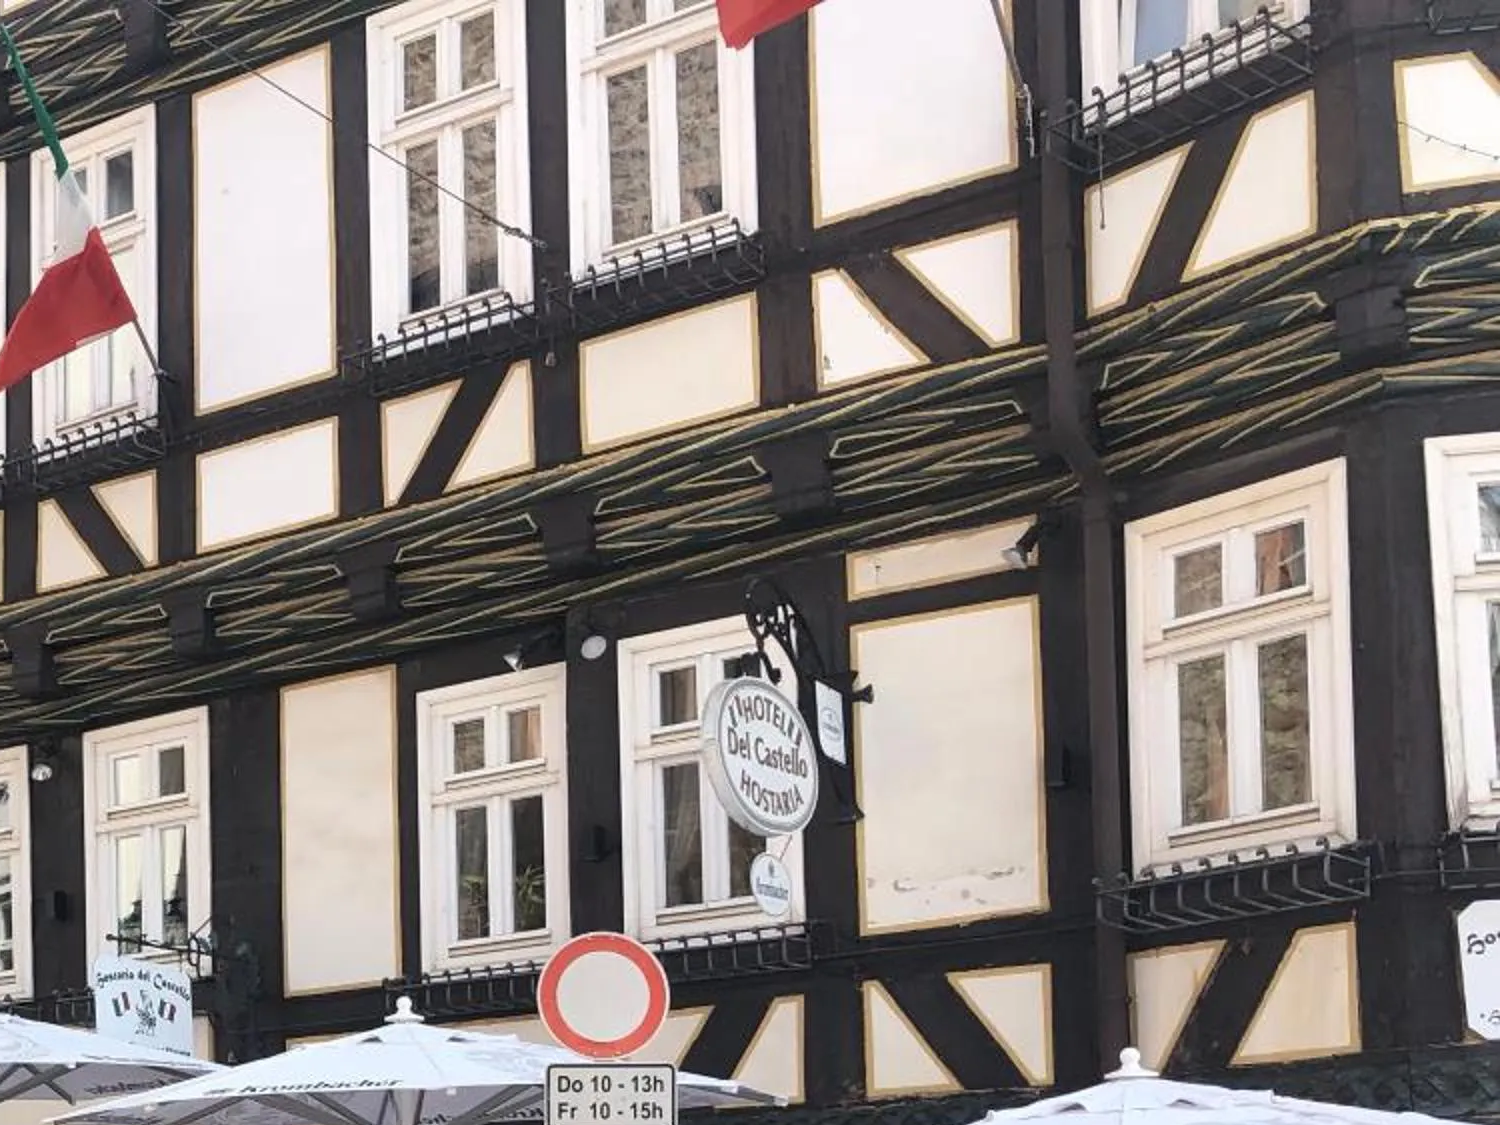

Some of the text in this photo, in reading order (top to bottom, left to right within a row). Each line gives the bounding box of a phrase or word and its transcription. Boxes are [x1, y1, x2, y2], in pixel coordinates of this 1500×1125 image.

[743, 695, 787, 736] HOTEL
[727, 726, 808, 778] Del Castello
[740, 768, 805, 816] HOSTARIA
[241, 1080, 404, 1094] Krombacher
[557, 1075, 583, 1093] Do
[590, 1075, 611, 1093] 10
[631, 1075, 665, 1093] 13h
[557, 1102, 577, 1120] Fr
[589, 1102, 611, 1120] 10
[629, 1102, 663, 1120] 15h
